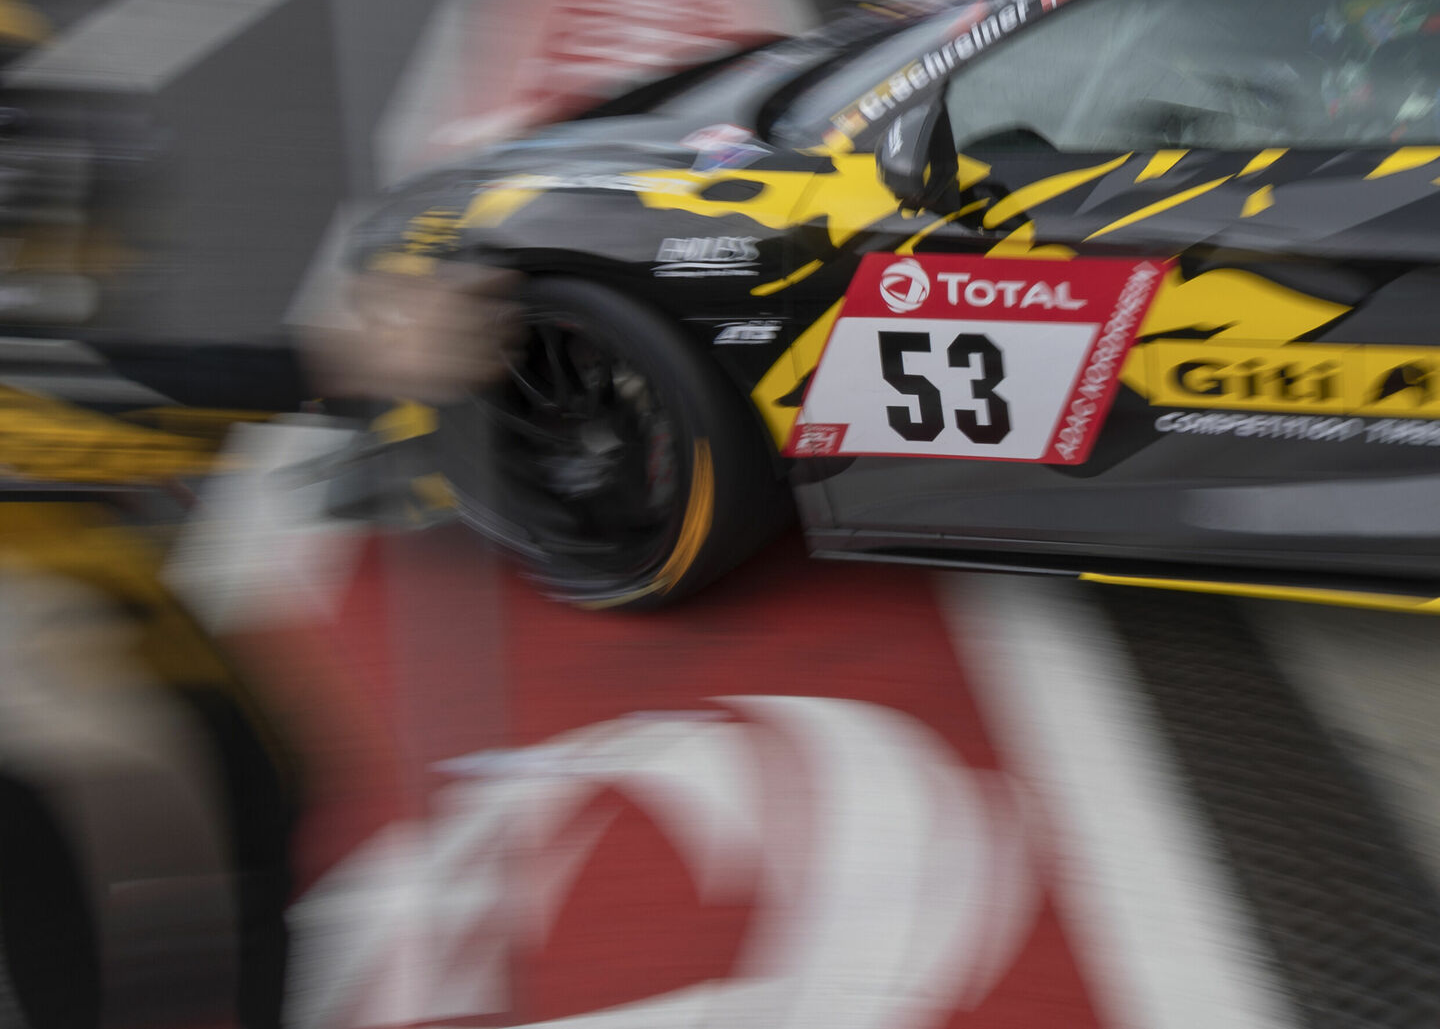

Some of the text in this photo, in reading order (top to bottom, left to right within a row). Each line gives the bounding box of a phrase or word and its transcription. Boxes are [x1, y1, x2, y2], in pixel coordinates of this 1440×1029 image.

[937, 272, 1089, 311] TOTAL
[878, 331, 1011, 445] 53
[1164, 357, 1346, 403] Giti
[1054, 399, 1096, 462] ADAC
